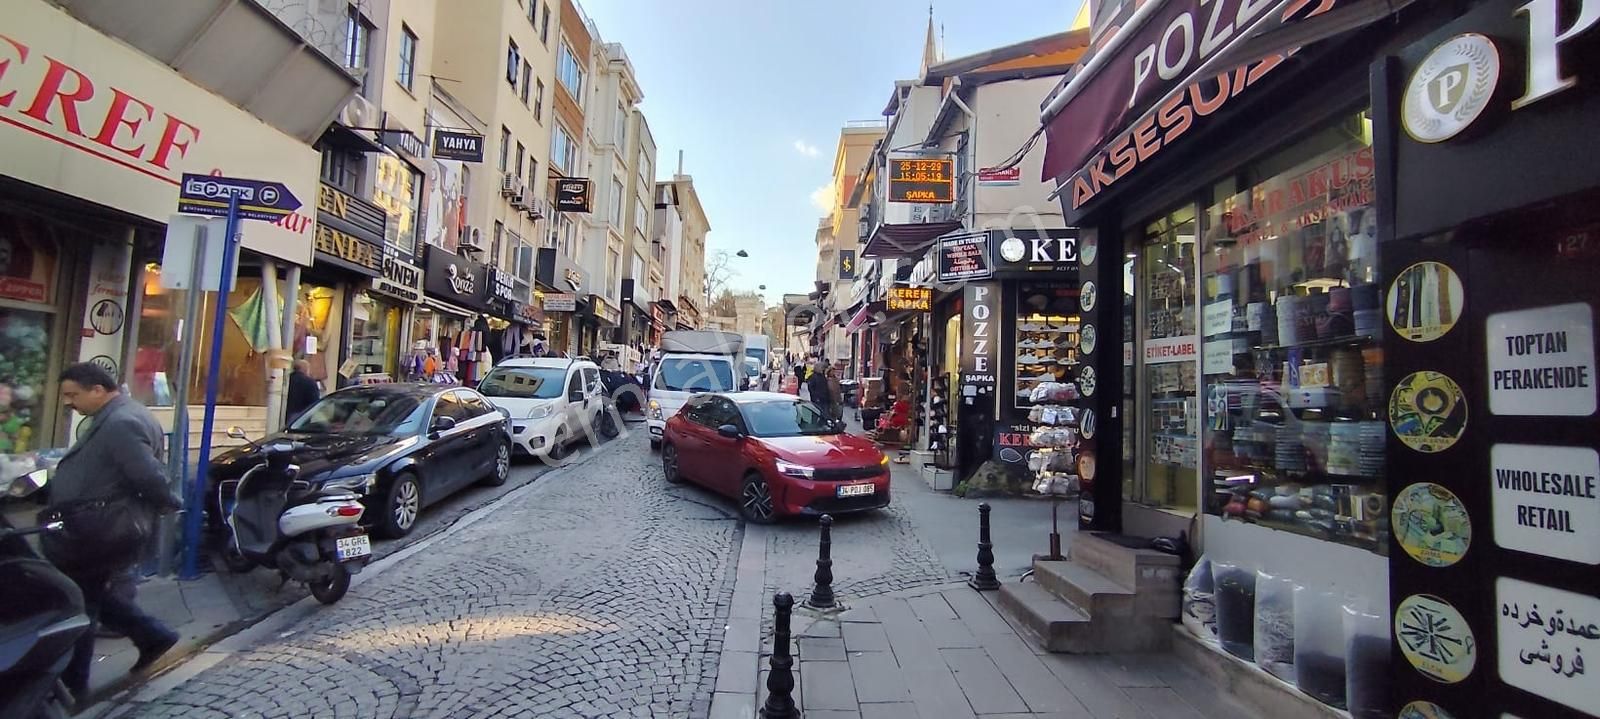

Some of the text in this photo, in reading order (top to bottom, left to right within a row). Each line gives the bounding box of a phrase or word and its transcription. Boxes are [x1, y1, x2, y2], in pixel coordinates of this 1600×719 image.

[1437, 69, 1463, 109] P
[1071, 45, 1301, 211] AKSESUA
[442, 135, 477, 151] YAHYA
[899, 162, 942, 172] 25-12-29
[899, 172, 942, 181] 15:05:19
[905, 190, 935, 200] ŞAPKA
[889, 287, 930, 298] KEREM
[889, 299, 930, 310] ŞAPKA
[972, 286, 990, 372] POZZE
[1145, 343, 1197, 359] ETİKET-LABEL
[1505, 330, 1568, 358] TOPTAN
[965, 374, 995, 383] ŞAPKA
[1493, 365, 1590, 391] PERAKENDE
[1496, 468, 1596, 500] WHOLESALE
[1516, 504, 1575, 533] RETAIL
[338, 536, 369, 548] 34 GRE
[345, 546, 362, 557] 822
